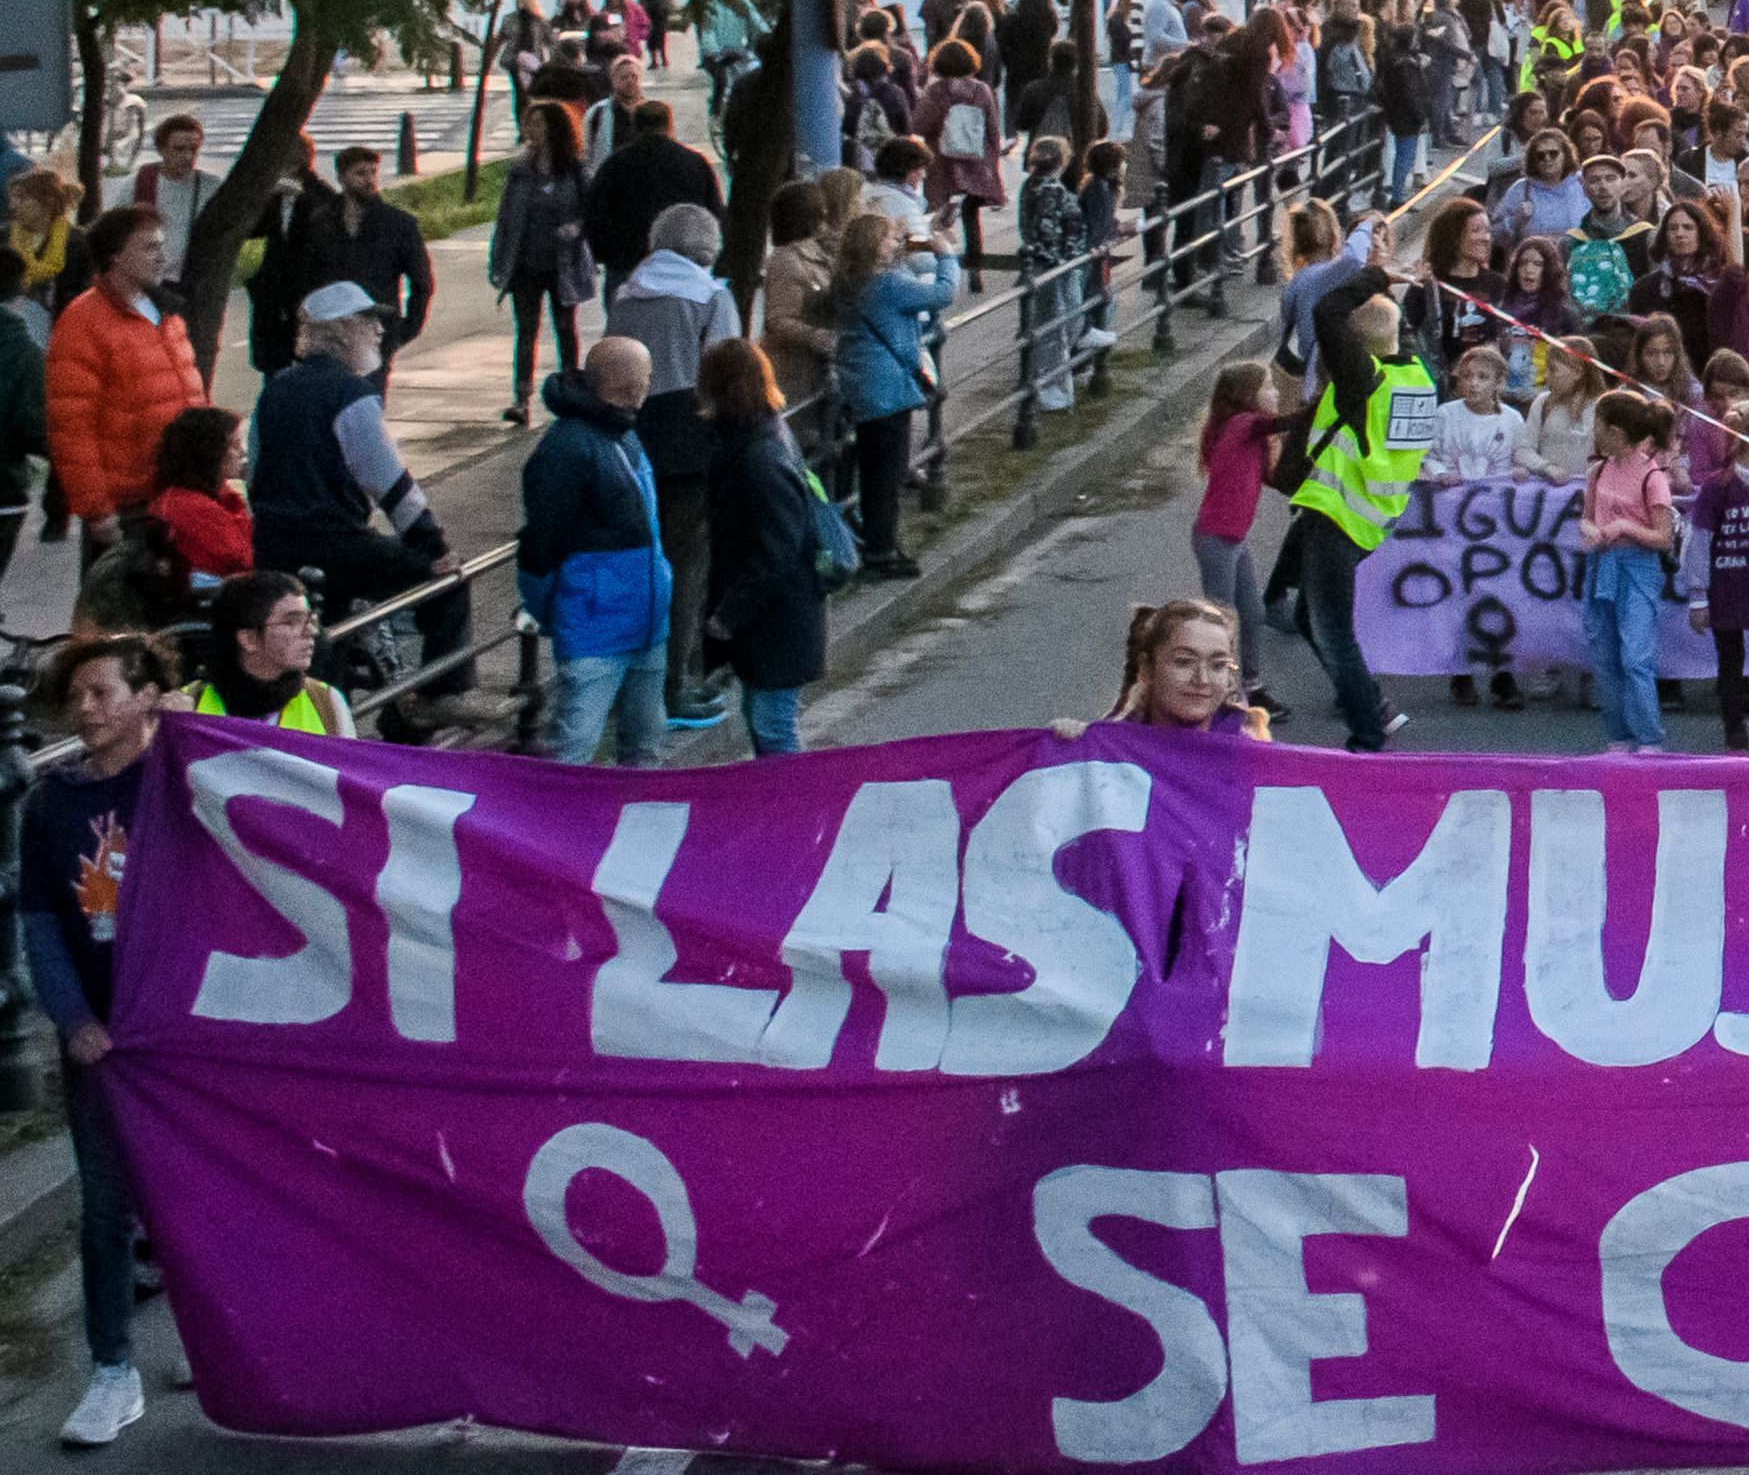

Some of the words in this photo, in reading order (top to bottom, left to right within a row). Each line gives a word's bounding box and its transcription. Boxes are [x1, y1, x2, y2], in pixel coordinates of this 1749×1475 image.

[1393, 479, 1586, 542] IGUA
[188, 746, 475, 1042] SI
[590, 761, 1152, 1076] LAS
[1033, 1164, 1435, 1464] SE
